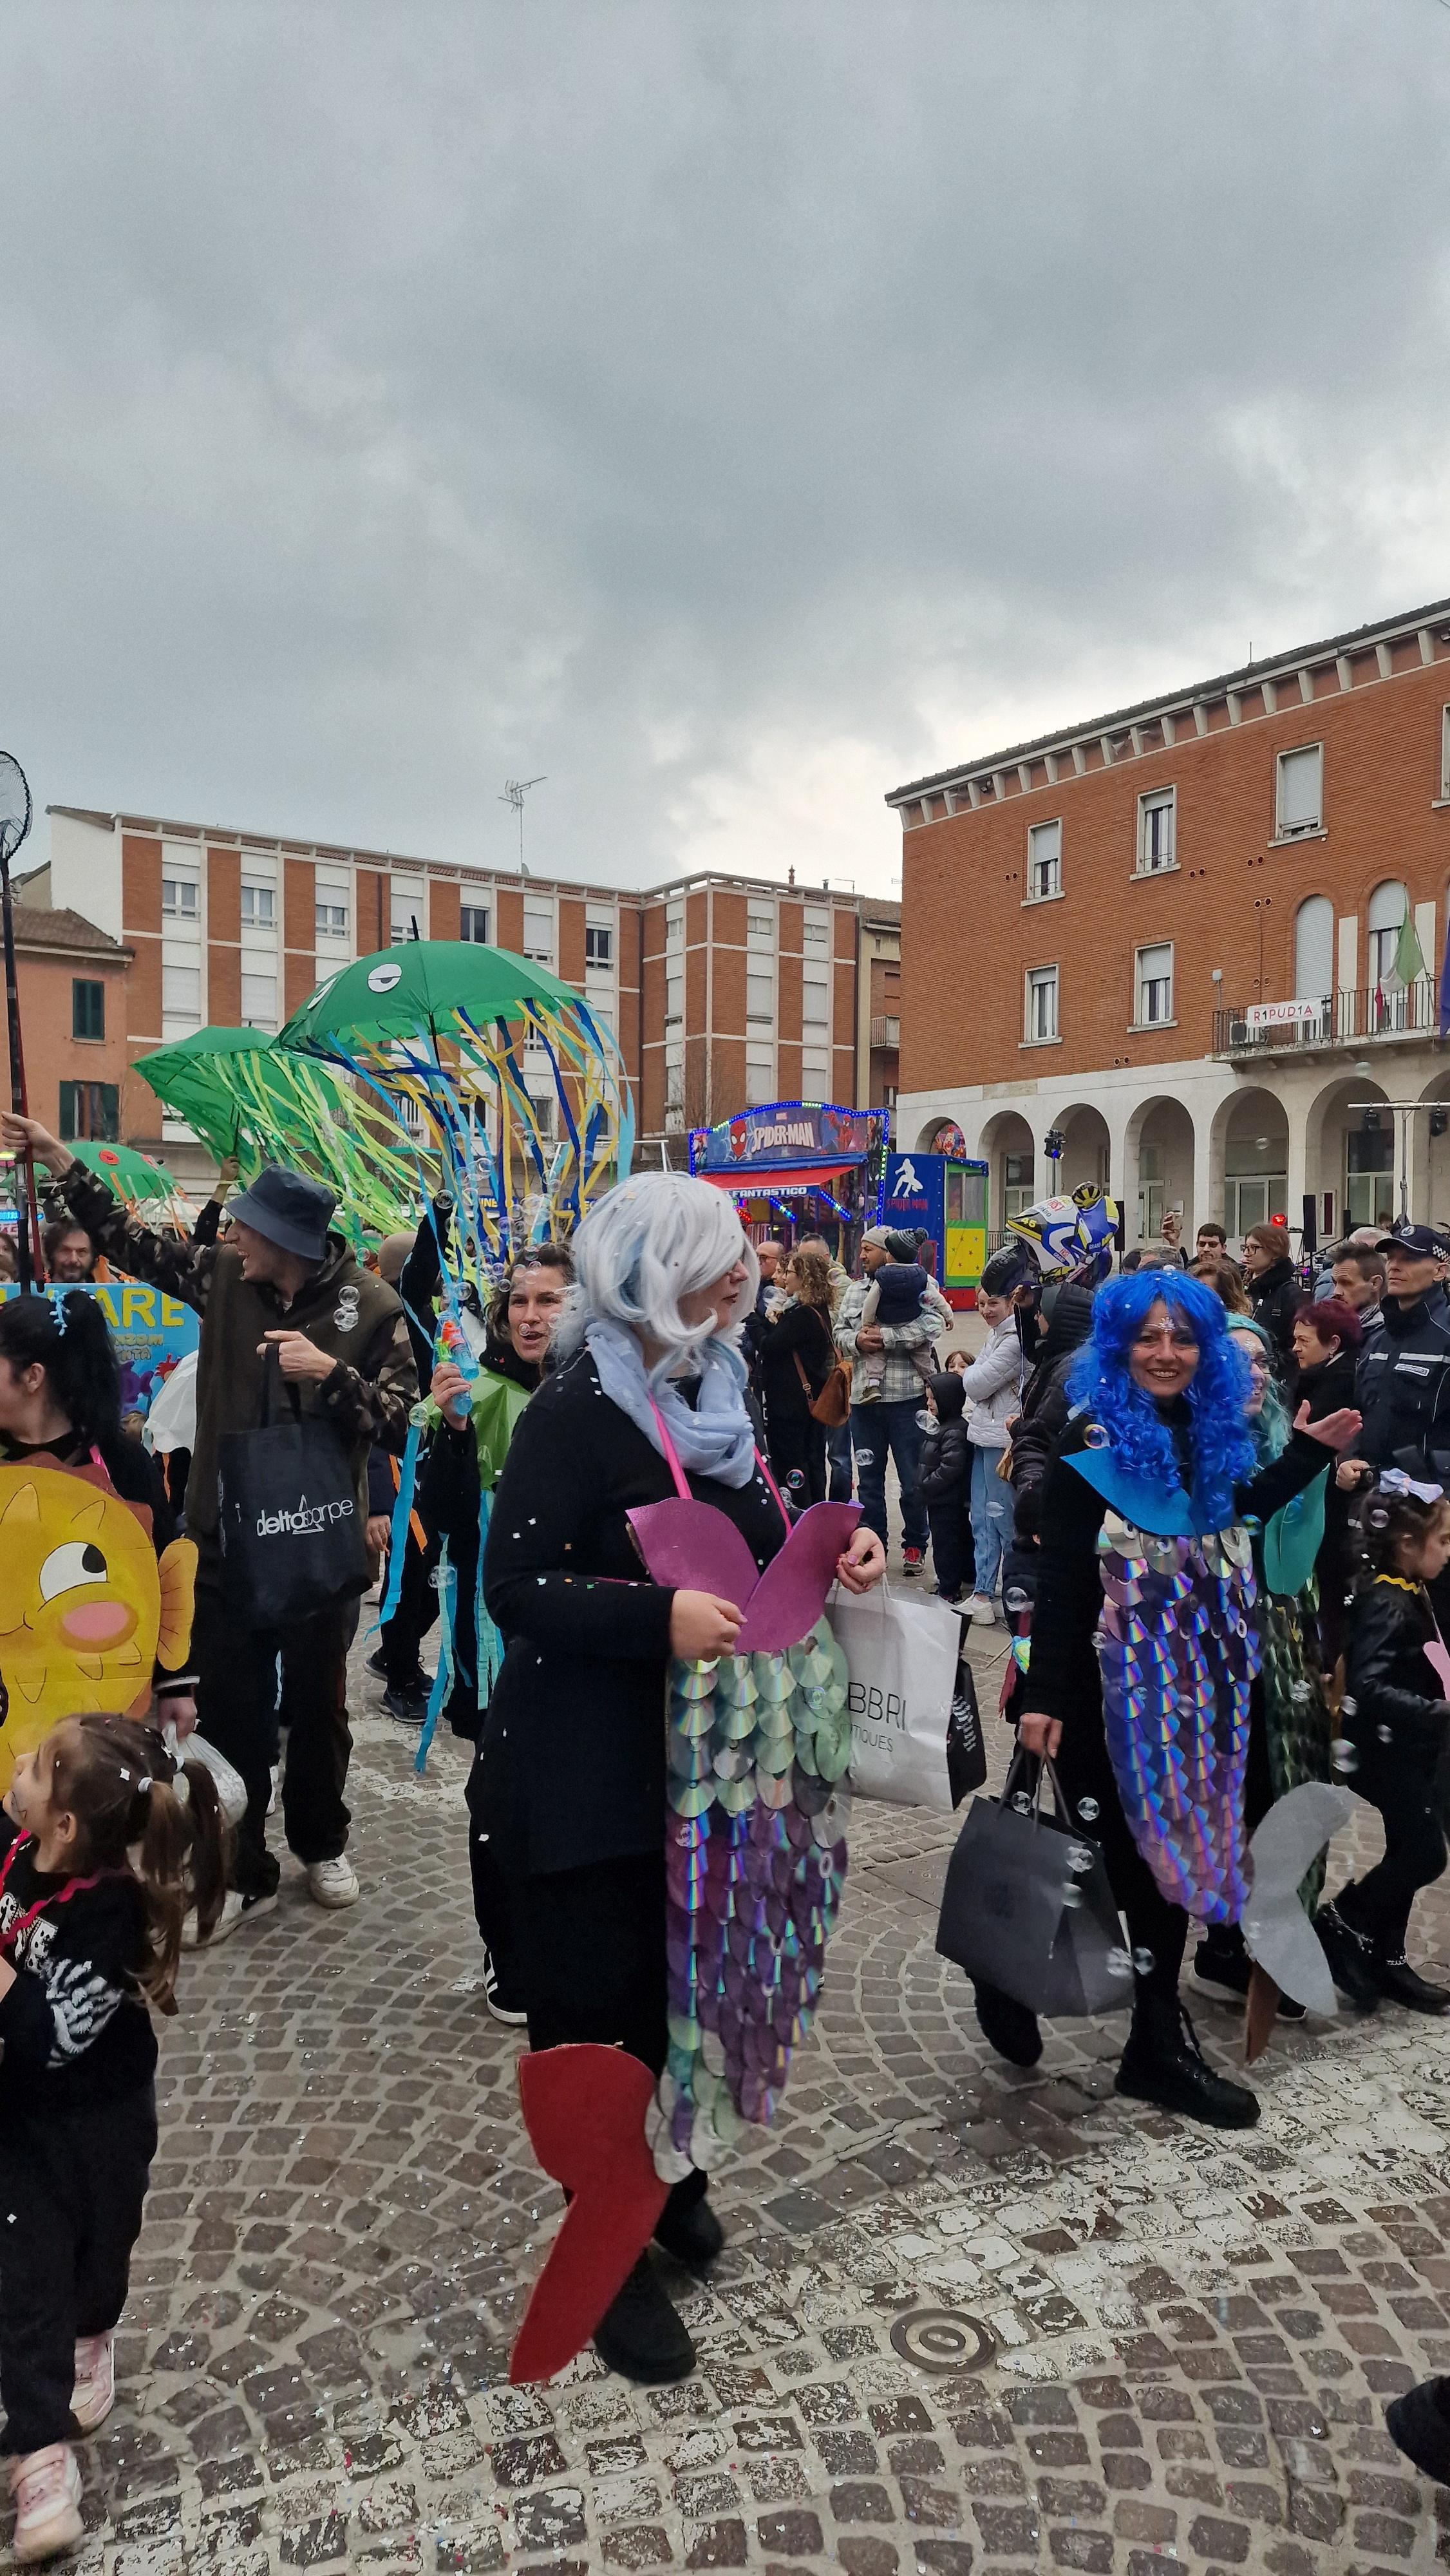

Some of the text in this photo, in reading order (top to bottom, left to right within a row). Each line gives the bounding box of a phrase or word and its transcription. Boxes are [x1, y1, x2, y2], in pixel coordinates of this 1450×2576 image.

[1253, 1005, 1313, 1021] R1PUD1A
[751, 1122, 815, 1153] SPIDER-MAN
[732, 1187, 807, 1198] FANTASTICO
[1021, 1217, 1037, 1228] 45
[94, 1287, 184, 1328] ARE
[847, 1681, 907, 1731] BBRI
[851, 1723, 894, 1752] TIQUES
